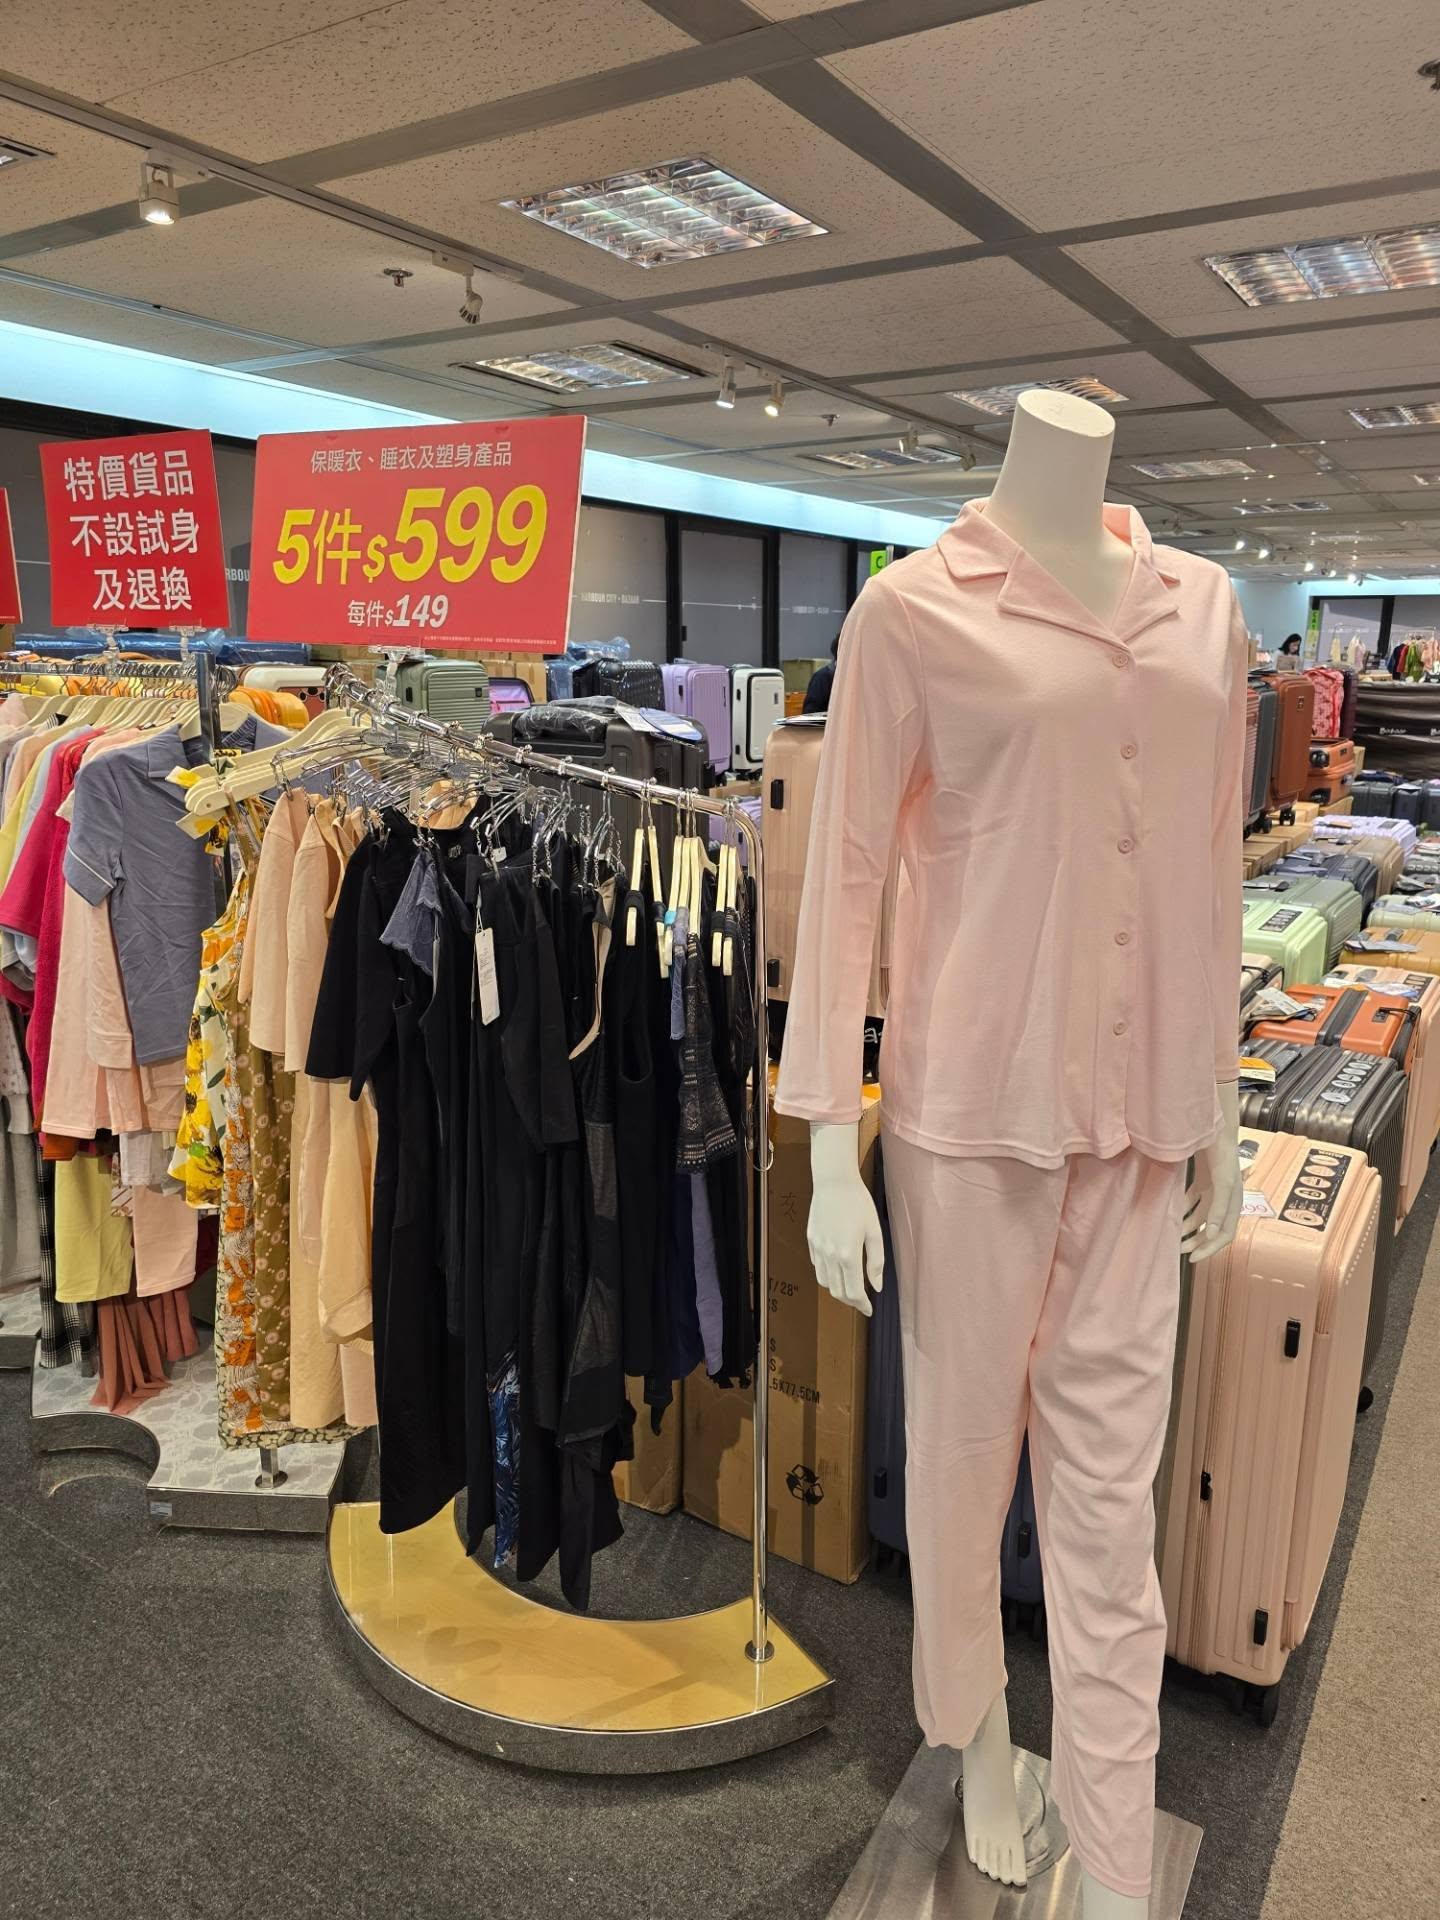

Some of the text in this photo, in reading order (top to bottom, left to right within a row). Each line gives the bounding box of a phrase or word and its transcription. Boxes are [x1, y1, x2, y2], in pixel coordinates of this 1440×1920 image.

[64, 450, 194, 502] 特價貨品
[311, 441, 512, 474] 保暖衣、睡衣及塑身產品
[69, 508, 199, 557] 不設試身
[92, 566, 192, 611] 及退換
